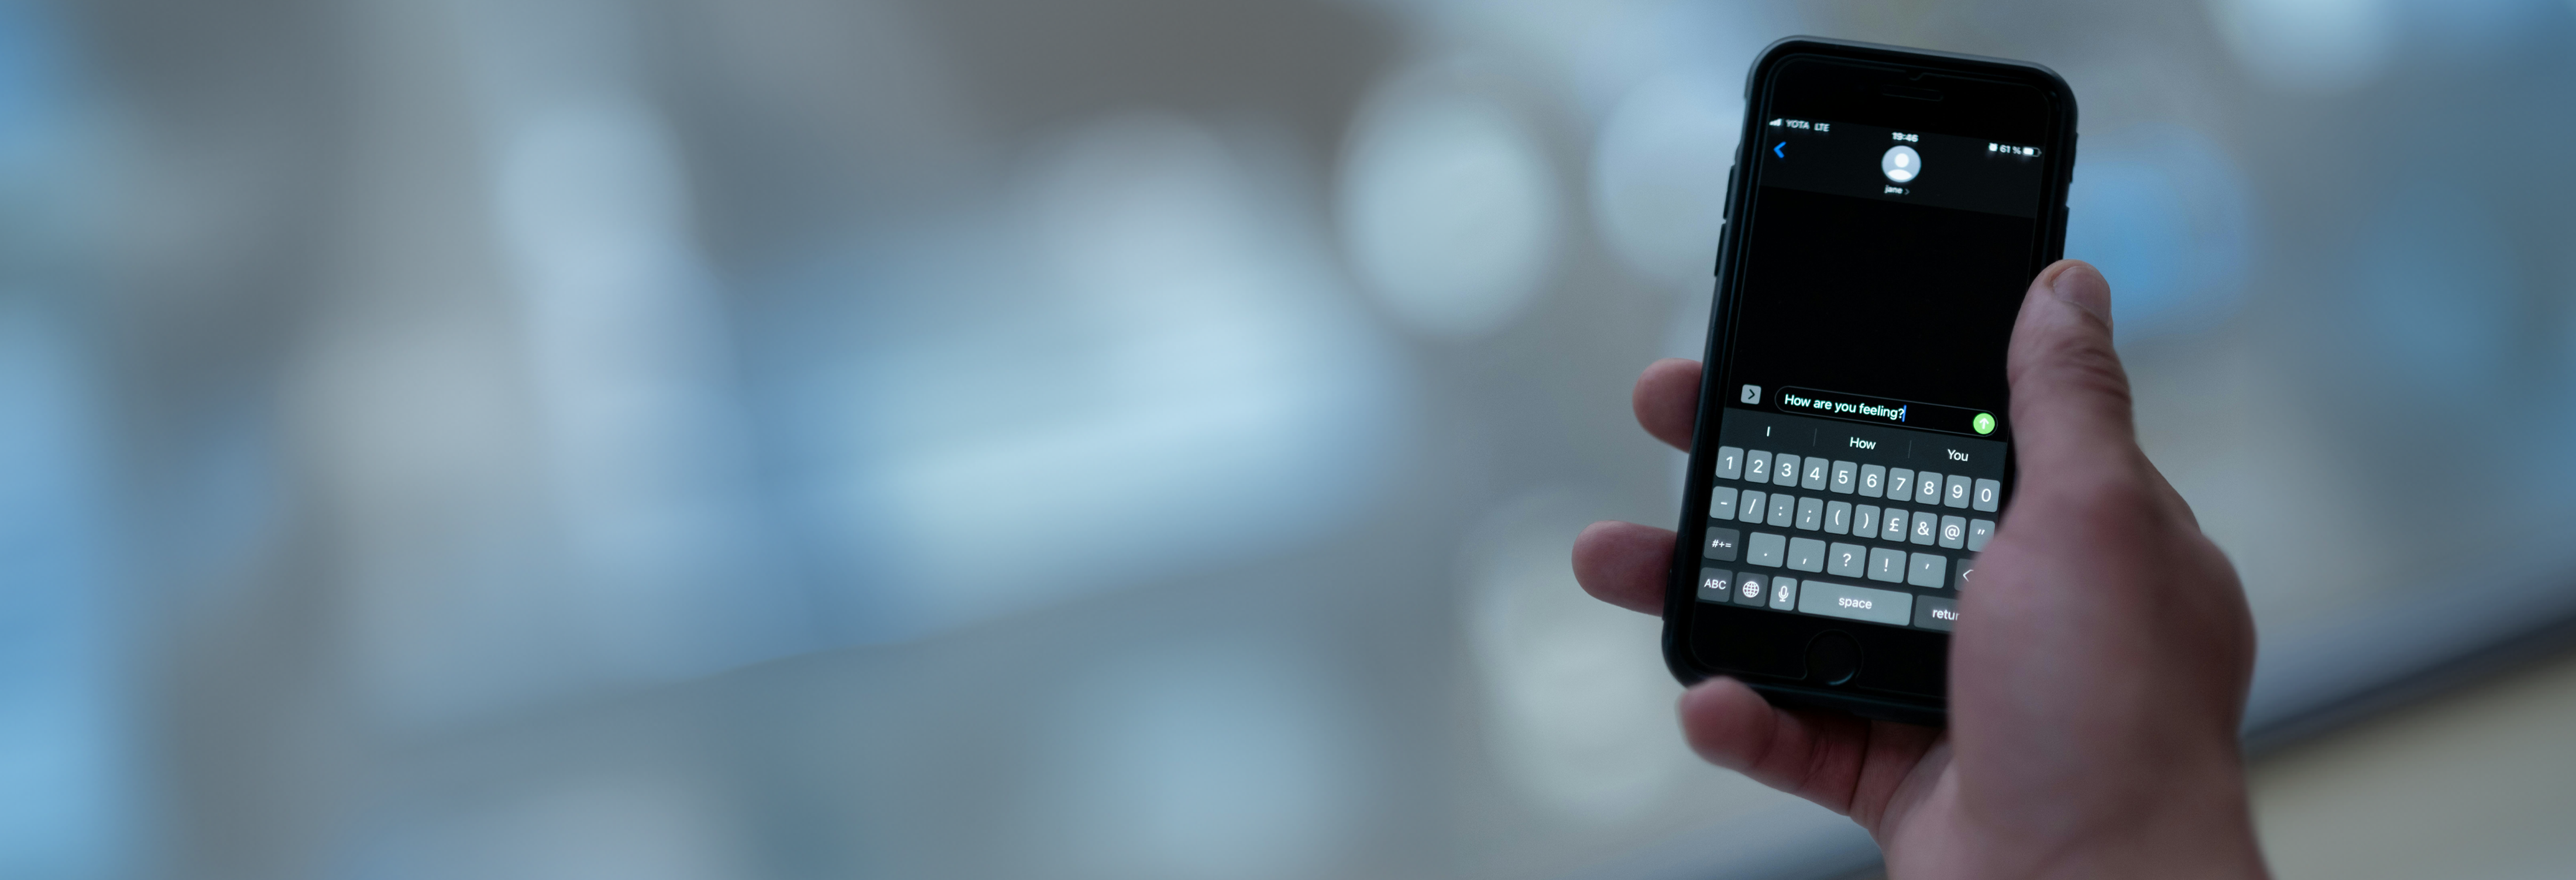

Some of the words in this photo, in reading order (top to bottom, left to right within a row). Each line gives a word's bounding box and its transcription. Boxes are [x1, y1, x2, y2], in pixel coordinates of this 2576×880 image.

[1786, 119, 1810, 129] YOTA
[1814, 123, 1829, 132] LTE
[1892, 132, 1919, 142] 19:46
[2000, 145, 2011, 153] 61
[2012, 146, 2022, 155] %
[1884, 185, 1903, 194] jane
[1784, 394, 1811, 407] How
[1813, 400, 1832, 410] are
[1834, 402, 1857, 413] you
[1859, 403, 1904, 419] feeling?
[1766, 426, 1771, 437] I
[1849, 436, 1877, 450] How
[1948, 449, 1969, 462] You
[1726, 456, 1733, 470] 1
[1753, 459, 1763, 474] 2
[1781, 463, 1792, 477] 3
[1809, 467, 1820, 481] 4
[1838, 470, 1849, 484] 5
[1867, 473, 1877, 488] 6
[1896, 477, 1906, 491] 7
[1924, 481, 1934, 495] 8
[1952, 484, 1963, 499] 9
[1981, 488, 1991, 503] 0
[1748, 499, 1757, 514] /
[1778, 506, 1783, 516] :
[1806, 510, 1812, 523] ;
[1835, 510, 1841, 525] (
[1863, 513, 1869, 529] )
[1889, 518, 1900, 532] £
[1917, 521, 1929, 536] &
[1945, 524, 1960, 540] @
[1712, 539, 1732, 548] #+=
[1843, 553, 1852, 567] ?
[1884, 558, 1889, 572] !
[1703, 578, 1726, 590] ABC
[1838, 597, 1872, 610] space
[1932, 609, 1959, 620] retur
